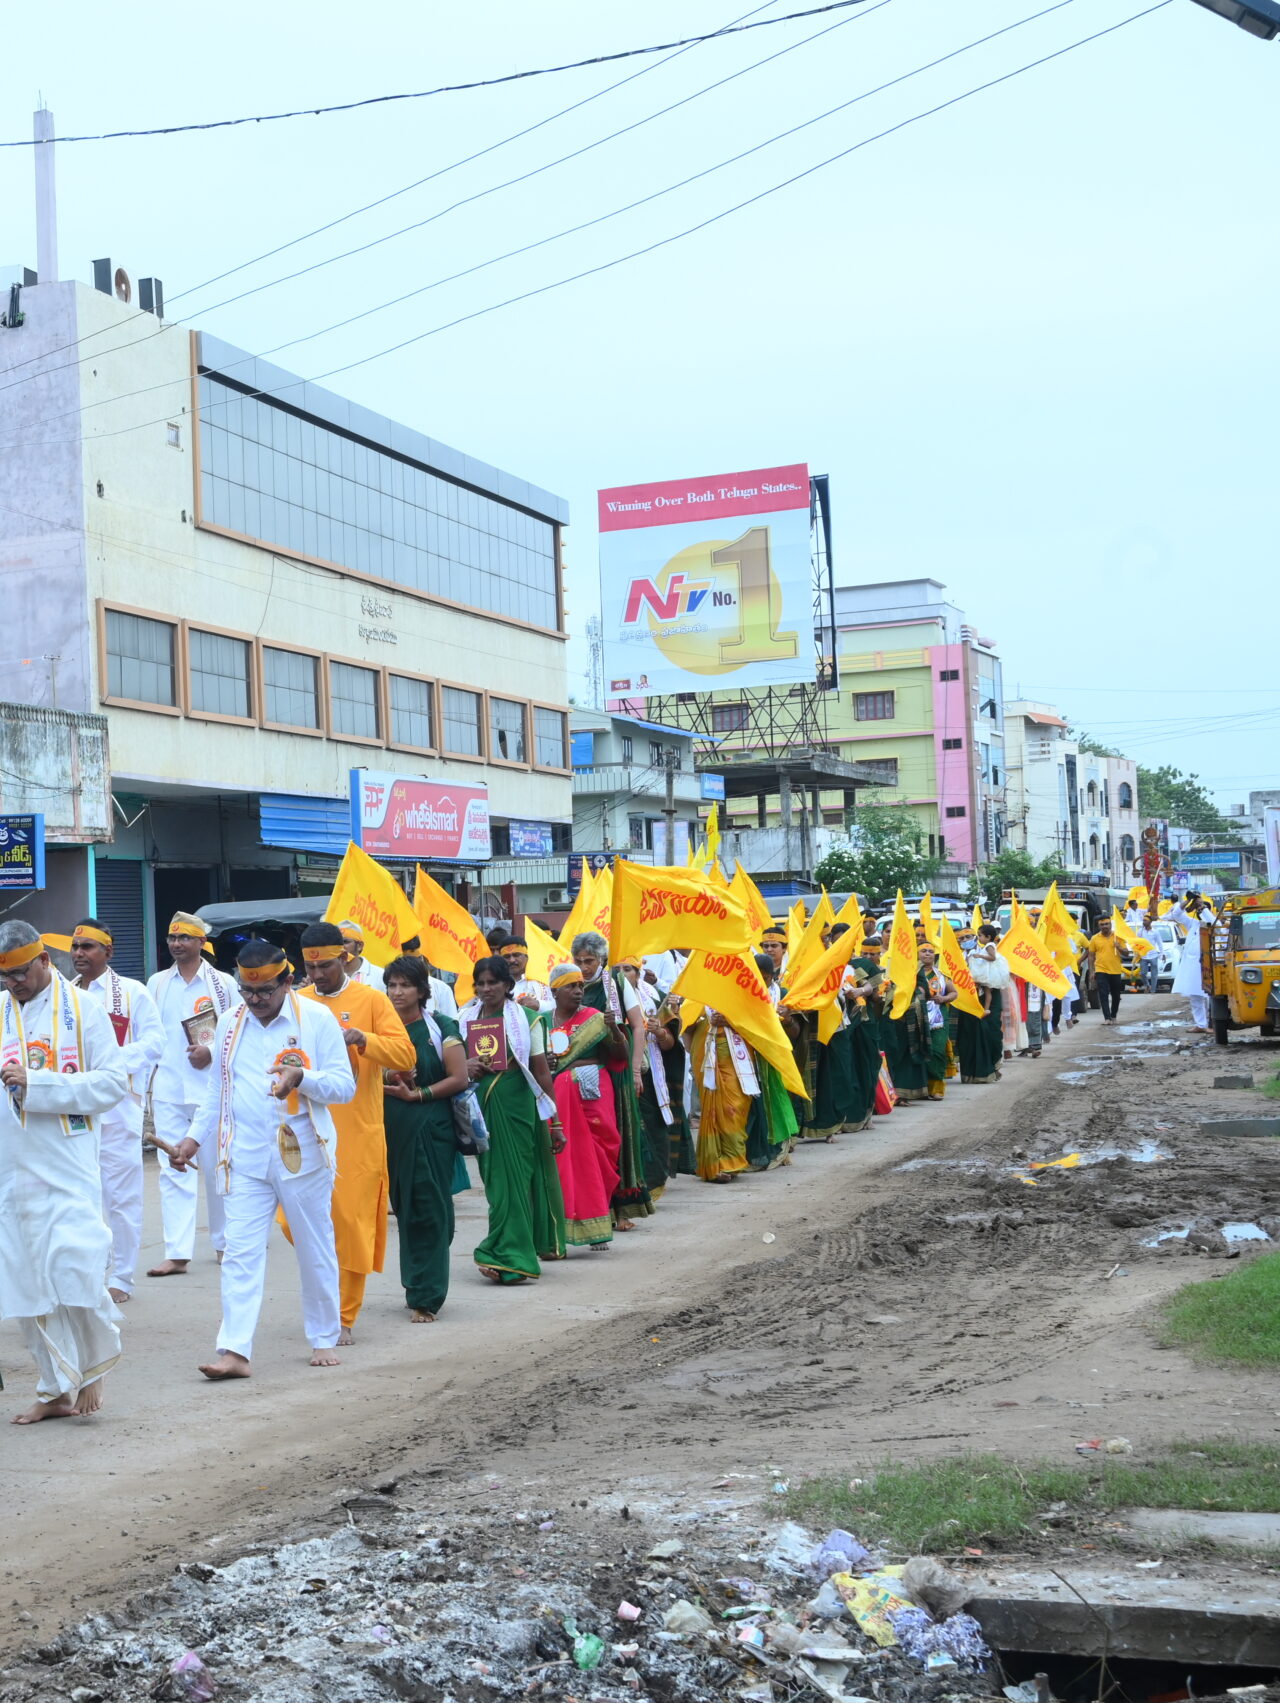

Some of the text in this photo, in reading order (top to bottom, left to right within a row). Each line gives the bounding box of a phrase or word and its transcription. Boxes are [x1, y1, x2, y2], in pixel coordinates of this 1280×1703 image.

[607, 499, 652, 512] Winning
[655, 496, 684, 508] Over
[687, 491, 716, 504] Both
[718, 487, 758, 500] Telugu
[711, 526, 799, 665] No. 1
